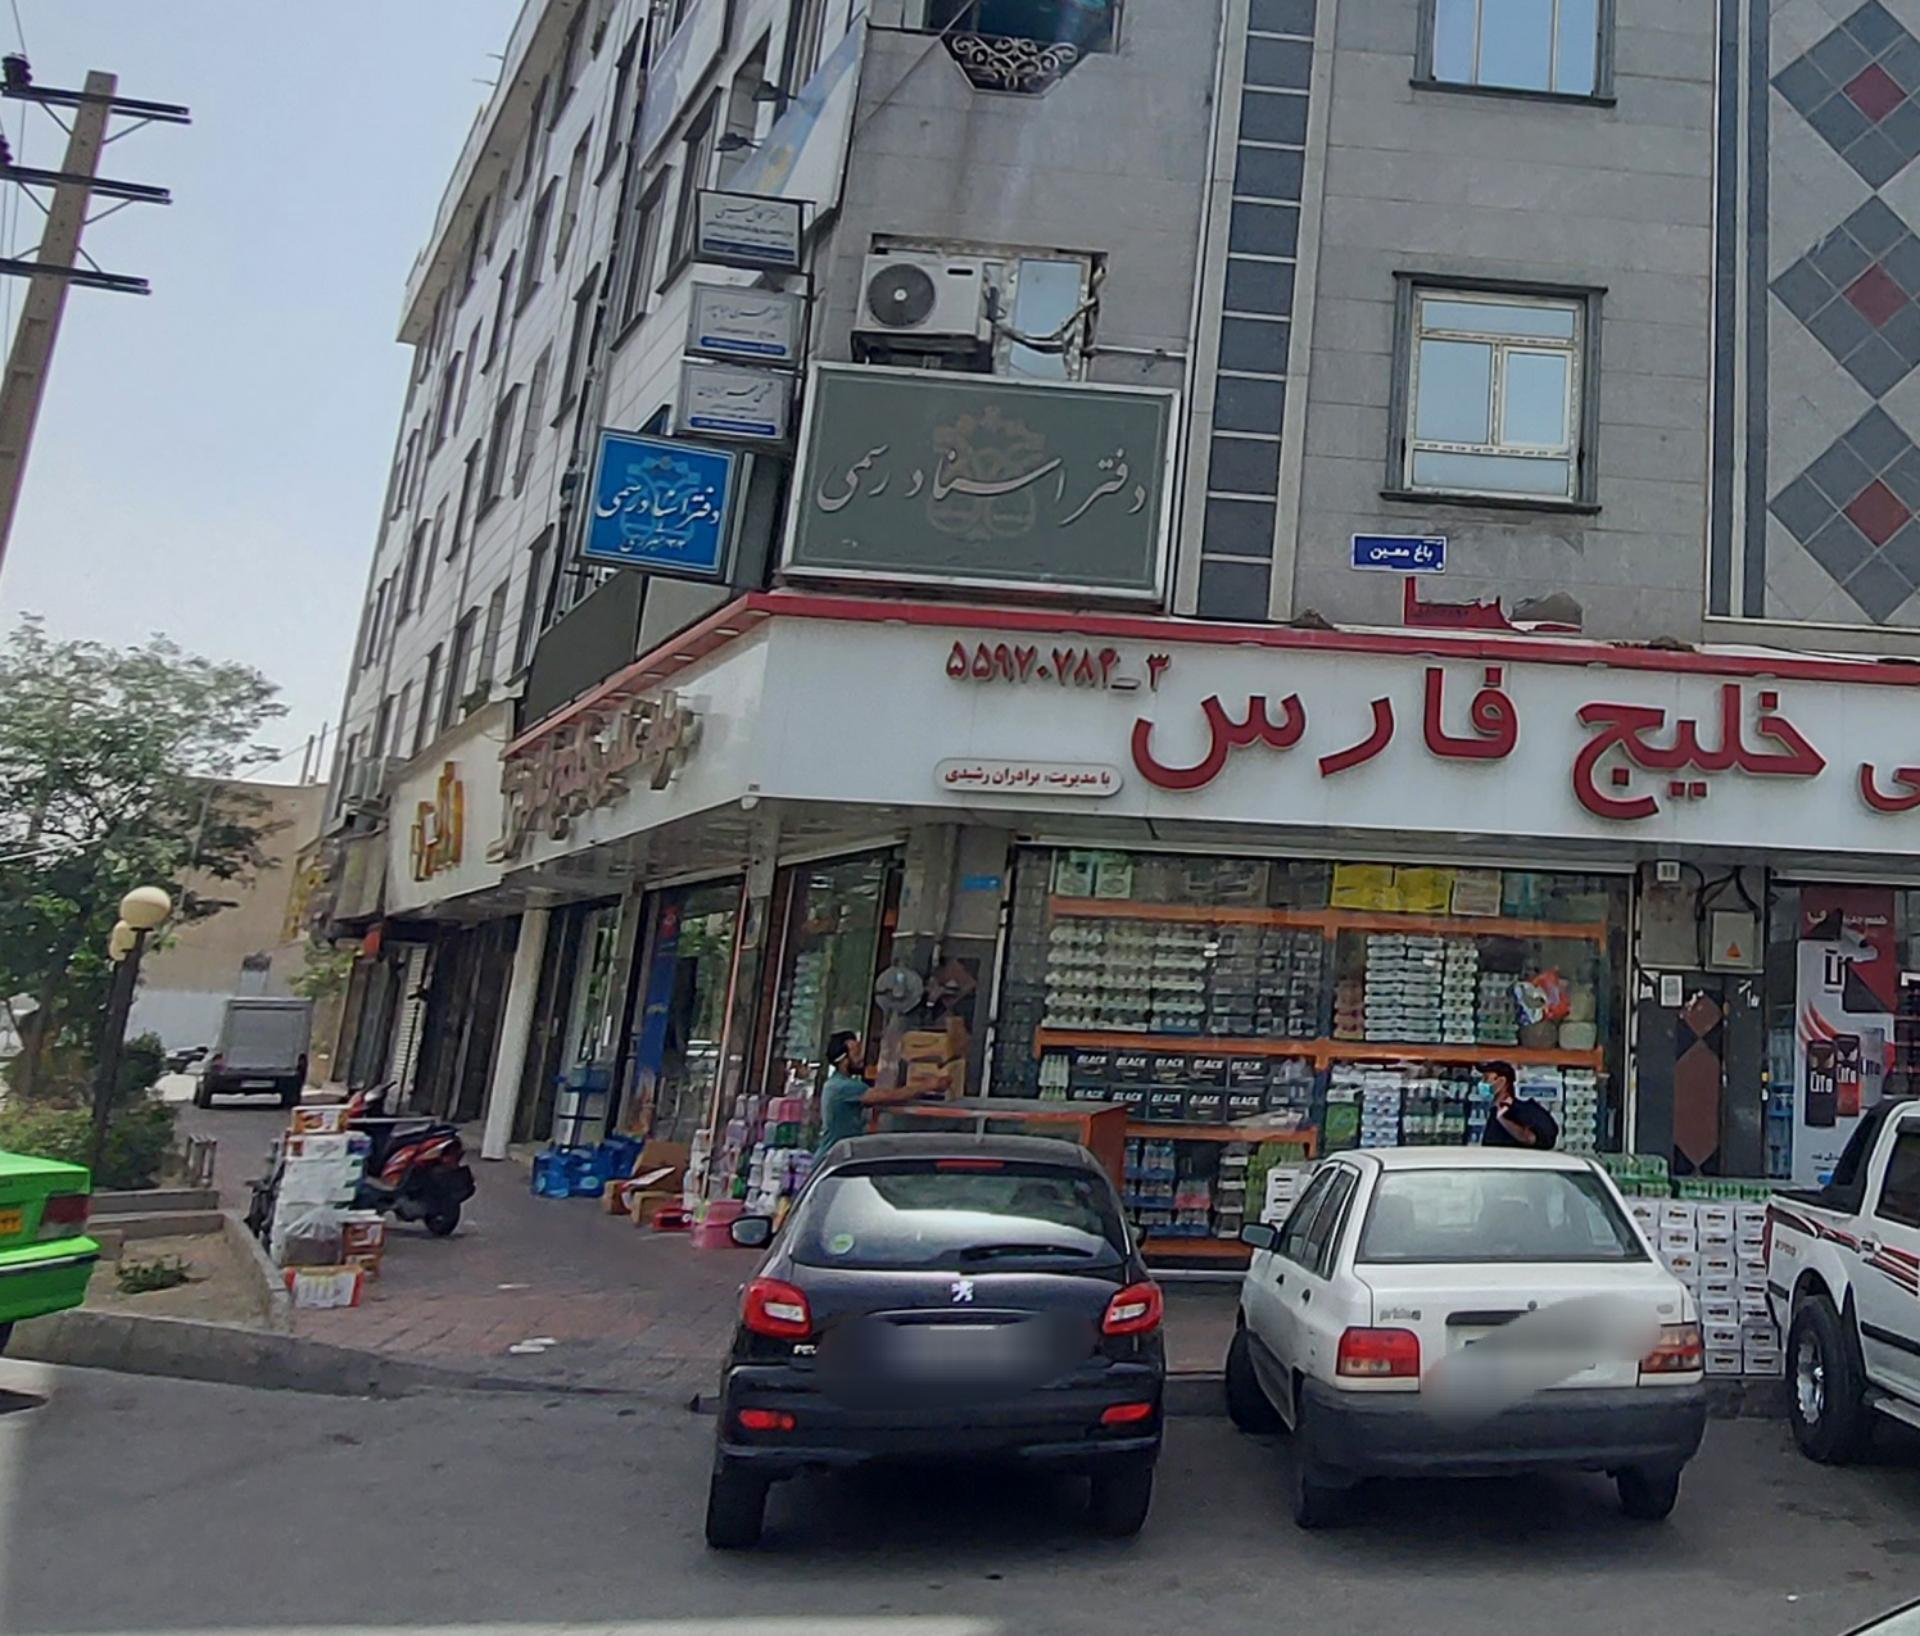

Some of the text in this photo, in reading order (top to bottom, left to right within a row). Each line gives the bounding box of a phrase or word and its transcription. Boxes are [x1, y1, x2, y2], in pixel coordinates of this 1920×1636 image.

[816, 443, 1147, 527] دفتر اسناد رسمی
[596, 484, 720, 525] دفتر اسناد رسمی
[1369, 544, 1433, 563] باغ معین
[1130, 665, 1520, 792] فارس
[1572, 682, 1828, 820] خلیج
[945, 766, 990, 785] رشیدی
[992, 768, 1040, 786] برادران
[1100, 771, 1111, 789] با
[1077, 1055, 1107, 1065] BLACK
[1115, 1056, 1146, 1068] BLACK
[1155, 1058, 1184, 1068] BLACK
[1193, 1059, 1225, 1070] BLACK
[1073, 1089, 1105, 1099] BLACK
[1112, 1091, 1144, 1101] BLACK
[1229, 1096, 1261, 1106] BLACK
